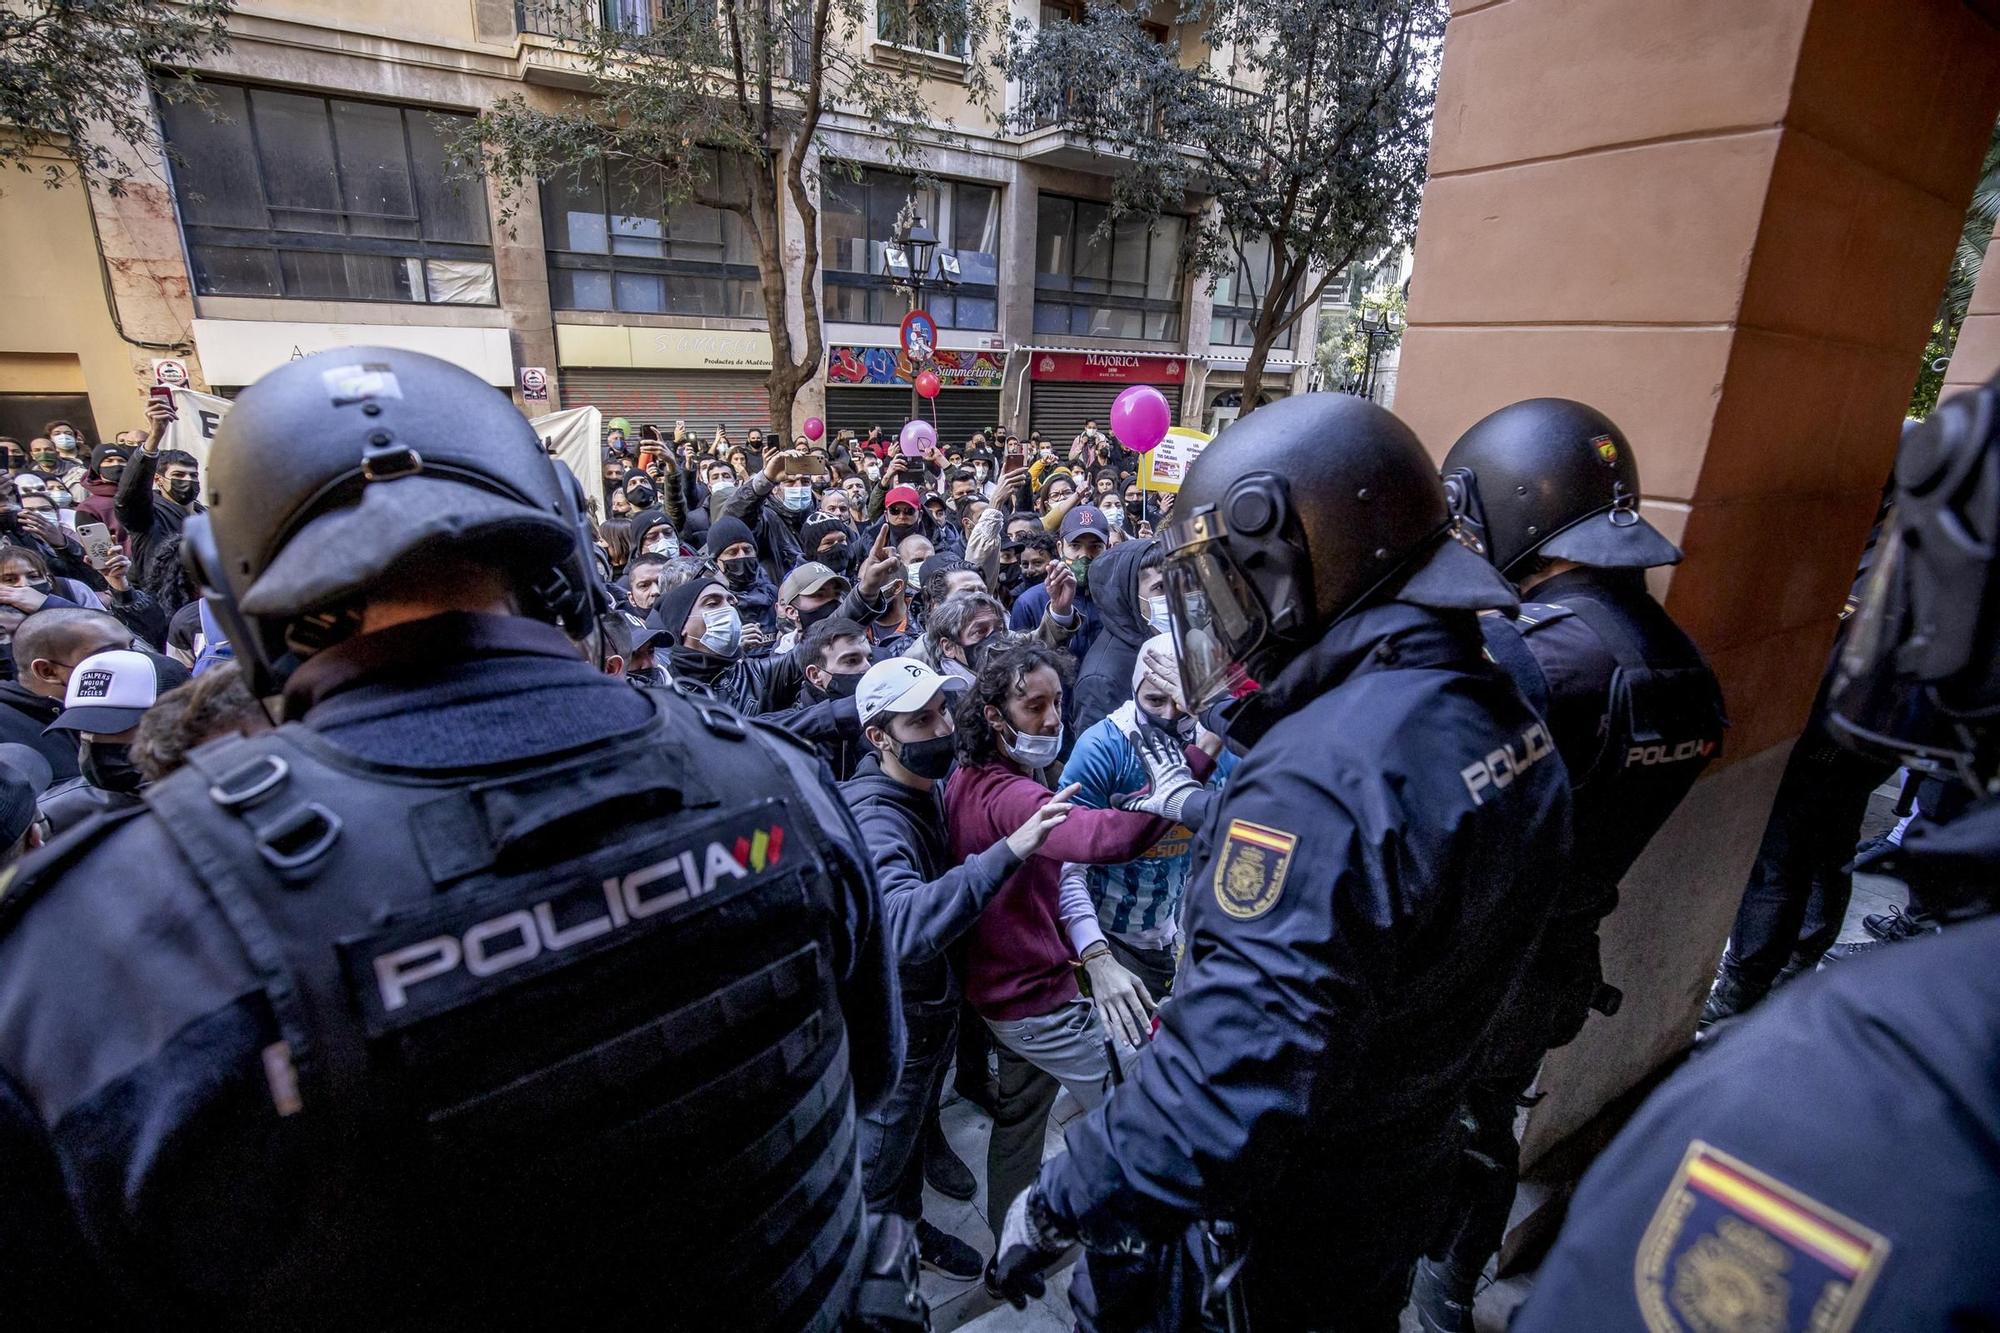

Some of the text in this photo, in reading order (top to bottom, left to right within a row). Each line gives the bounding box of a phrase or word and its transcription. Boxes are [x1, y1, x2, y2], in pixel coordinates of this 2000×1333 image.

[1086, 354, 1140, 367] MAJORICA
[935, 364, 997, 378] Summertime
[373, 841, 749, 1012] POLICIA
